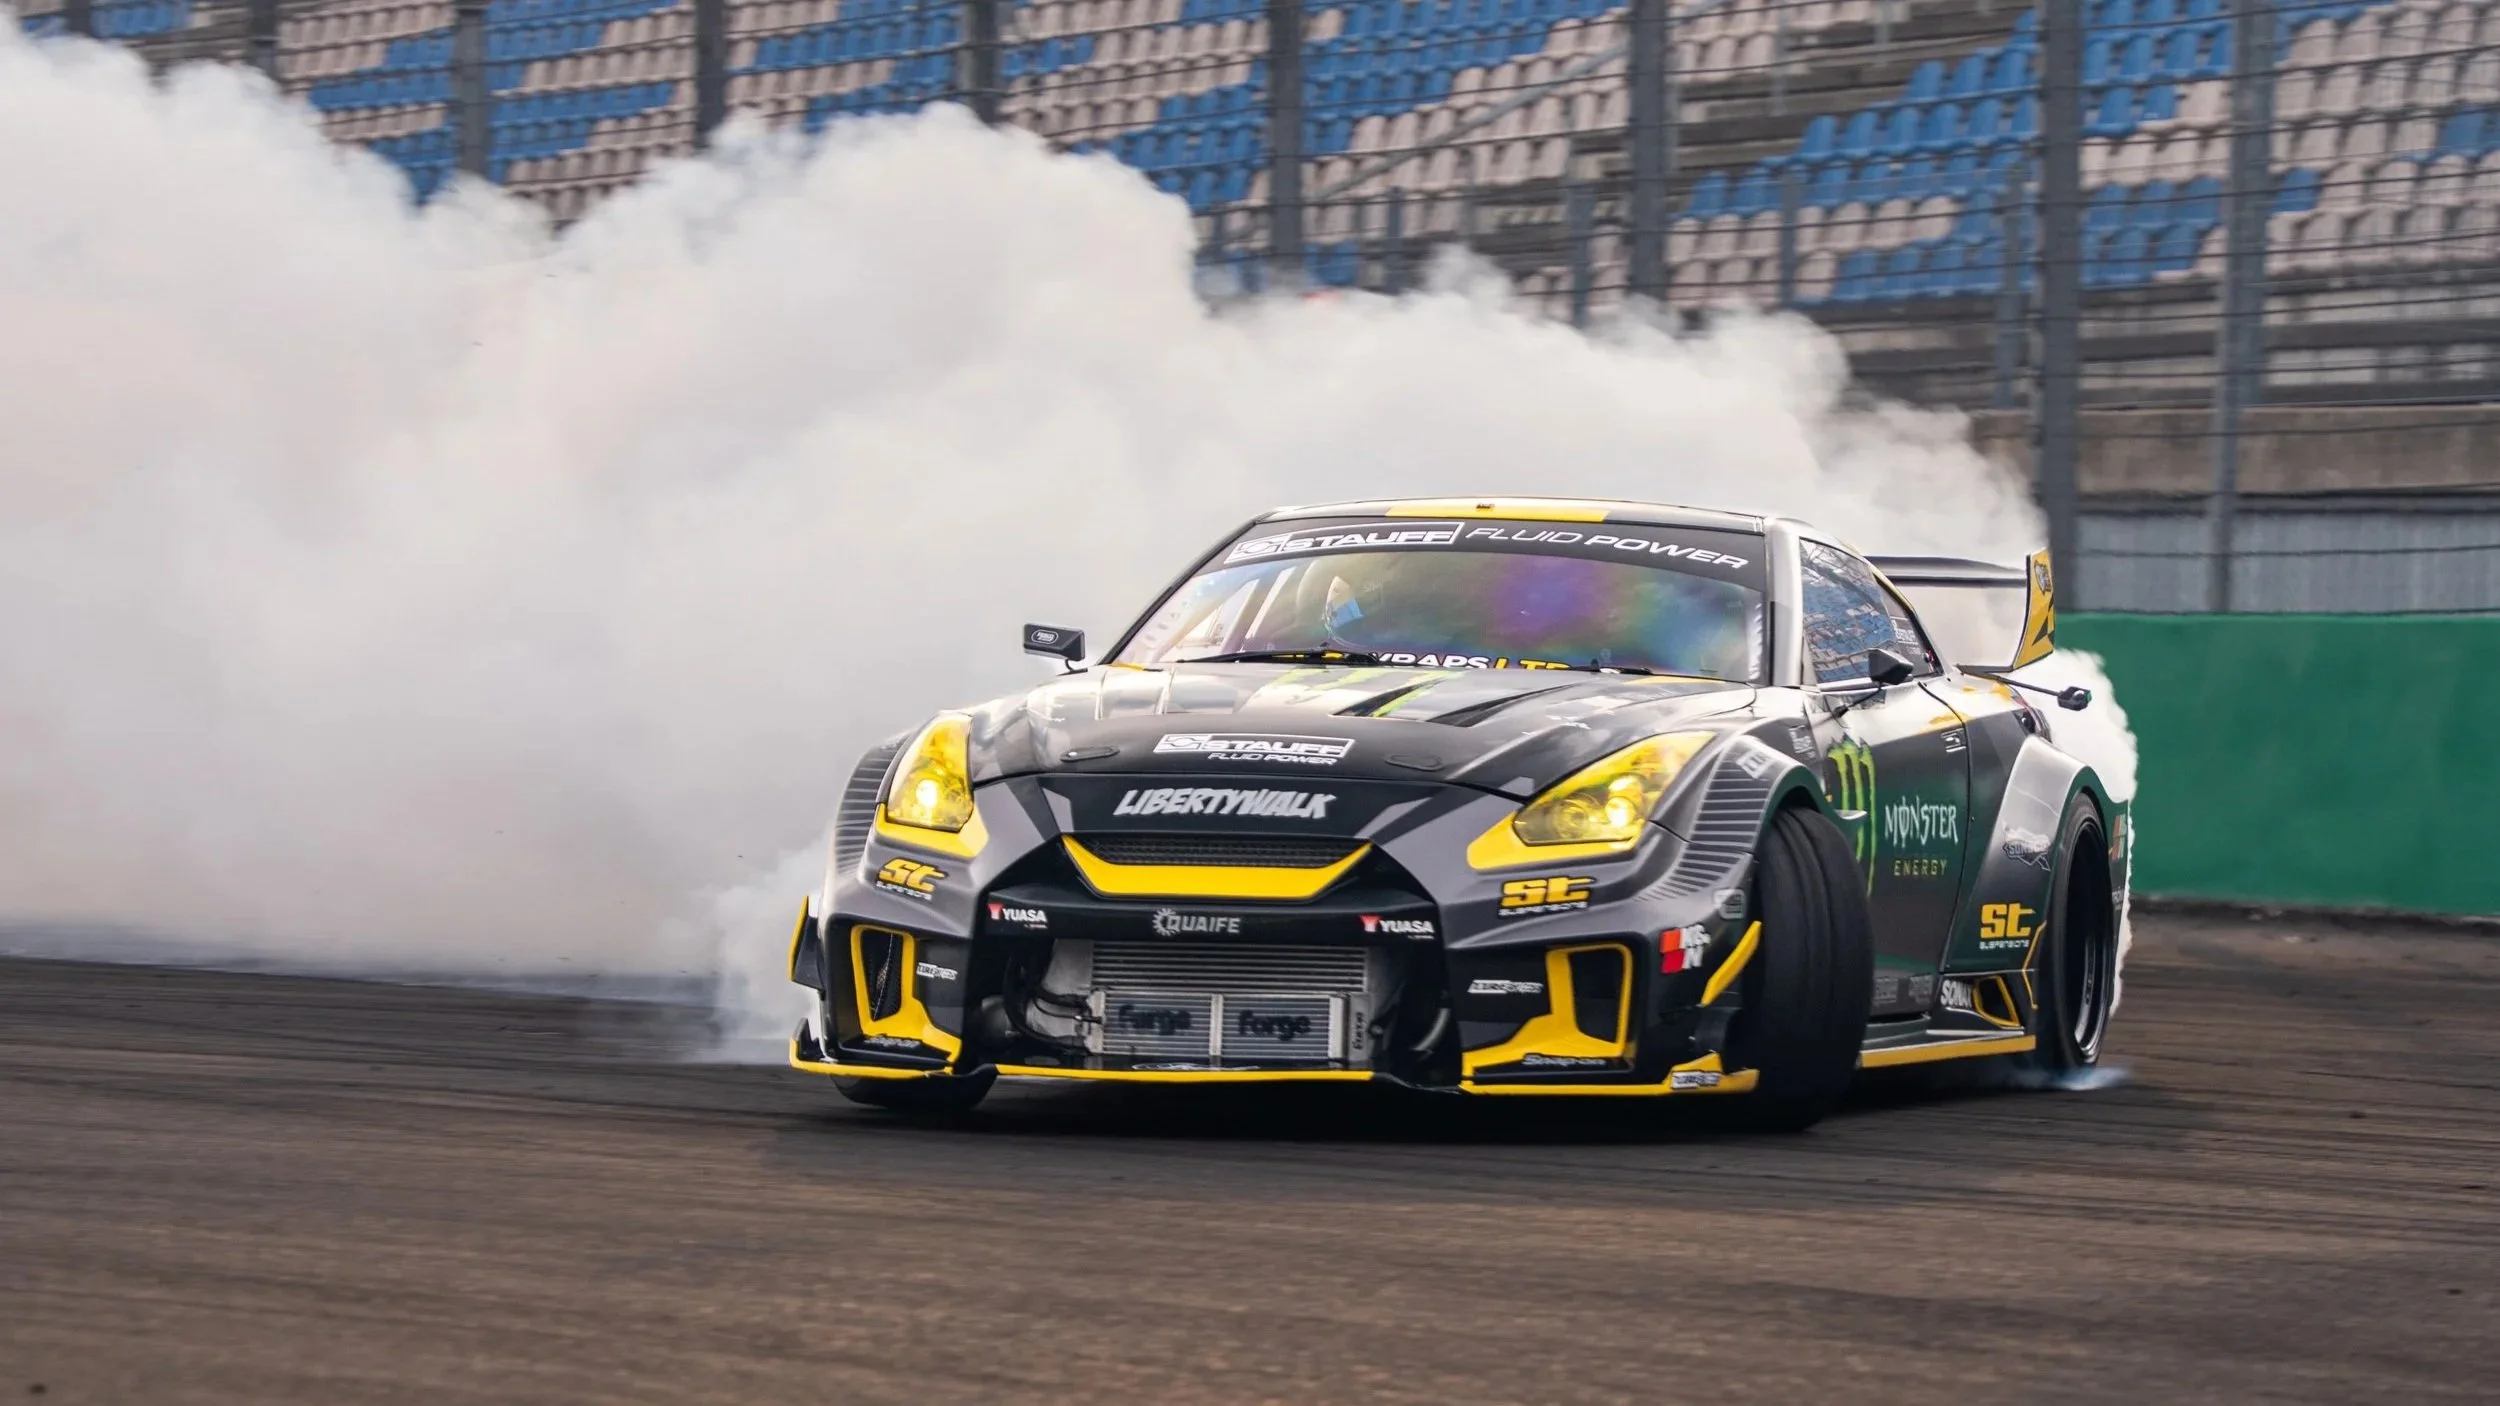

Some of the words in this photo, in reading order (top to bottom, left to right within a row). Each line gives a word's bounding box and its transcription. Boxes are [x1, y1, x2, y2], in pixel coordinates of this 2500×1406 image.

[1283, 530, 1454, 550] STAUFF
[1465, 526, 1584, 543] FLUID
[1584, 534, 1749, 569] POWER
[1203, 740, 1345, 756] STAUFF
[1207, 752, 1264, 761] FLUID
[1263, 753, 1338, 765] POWER
[1112, 787, 1337, 819] LIBERTYWALK
[1885, 795, 1959, 849] MONSTER
[1893, 859, 1948, 876] ENERGY
[1002, 907, 1048, 923] YUASA
[1161, 912, 1241, 935] QUAIFE
[1379, 918, 1436, 934] YUASA
